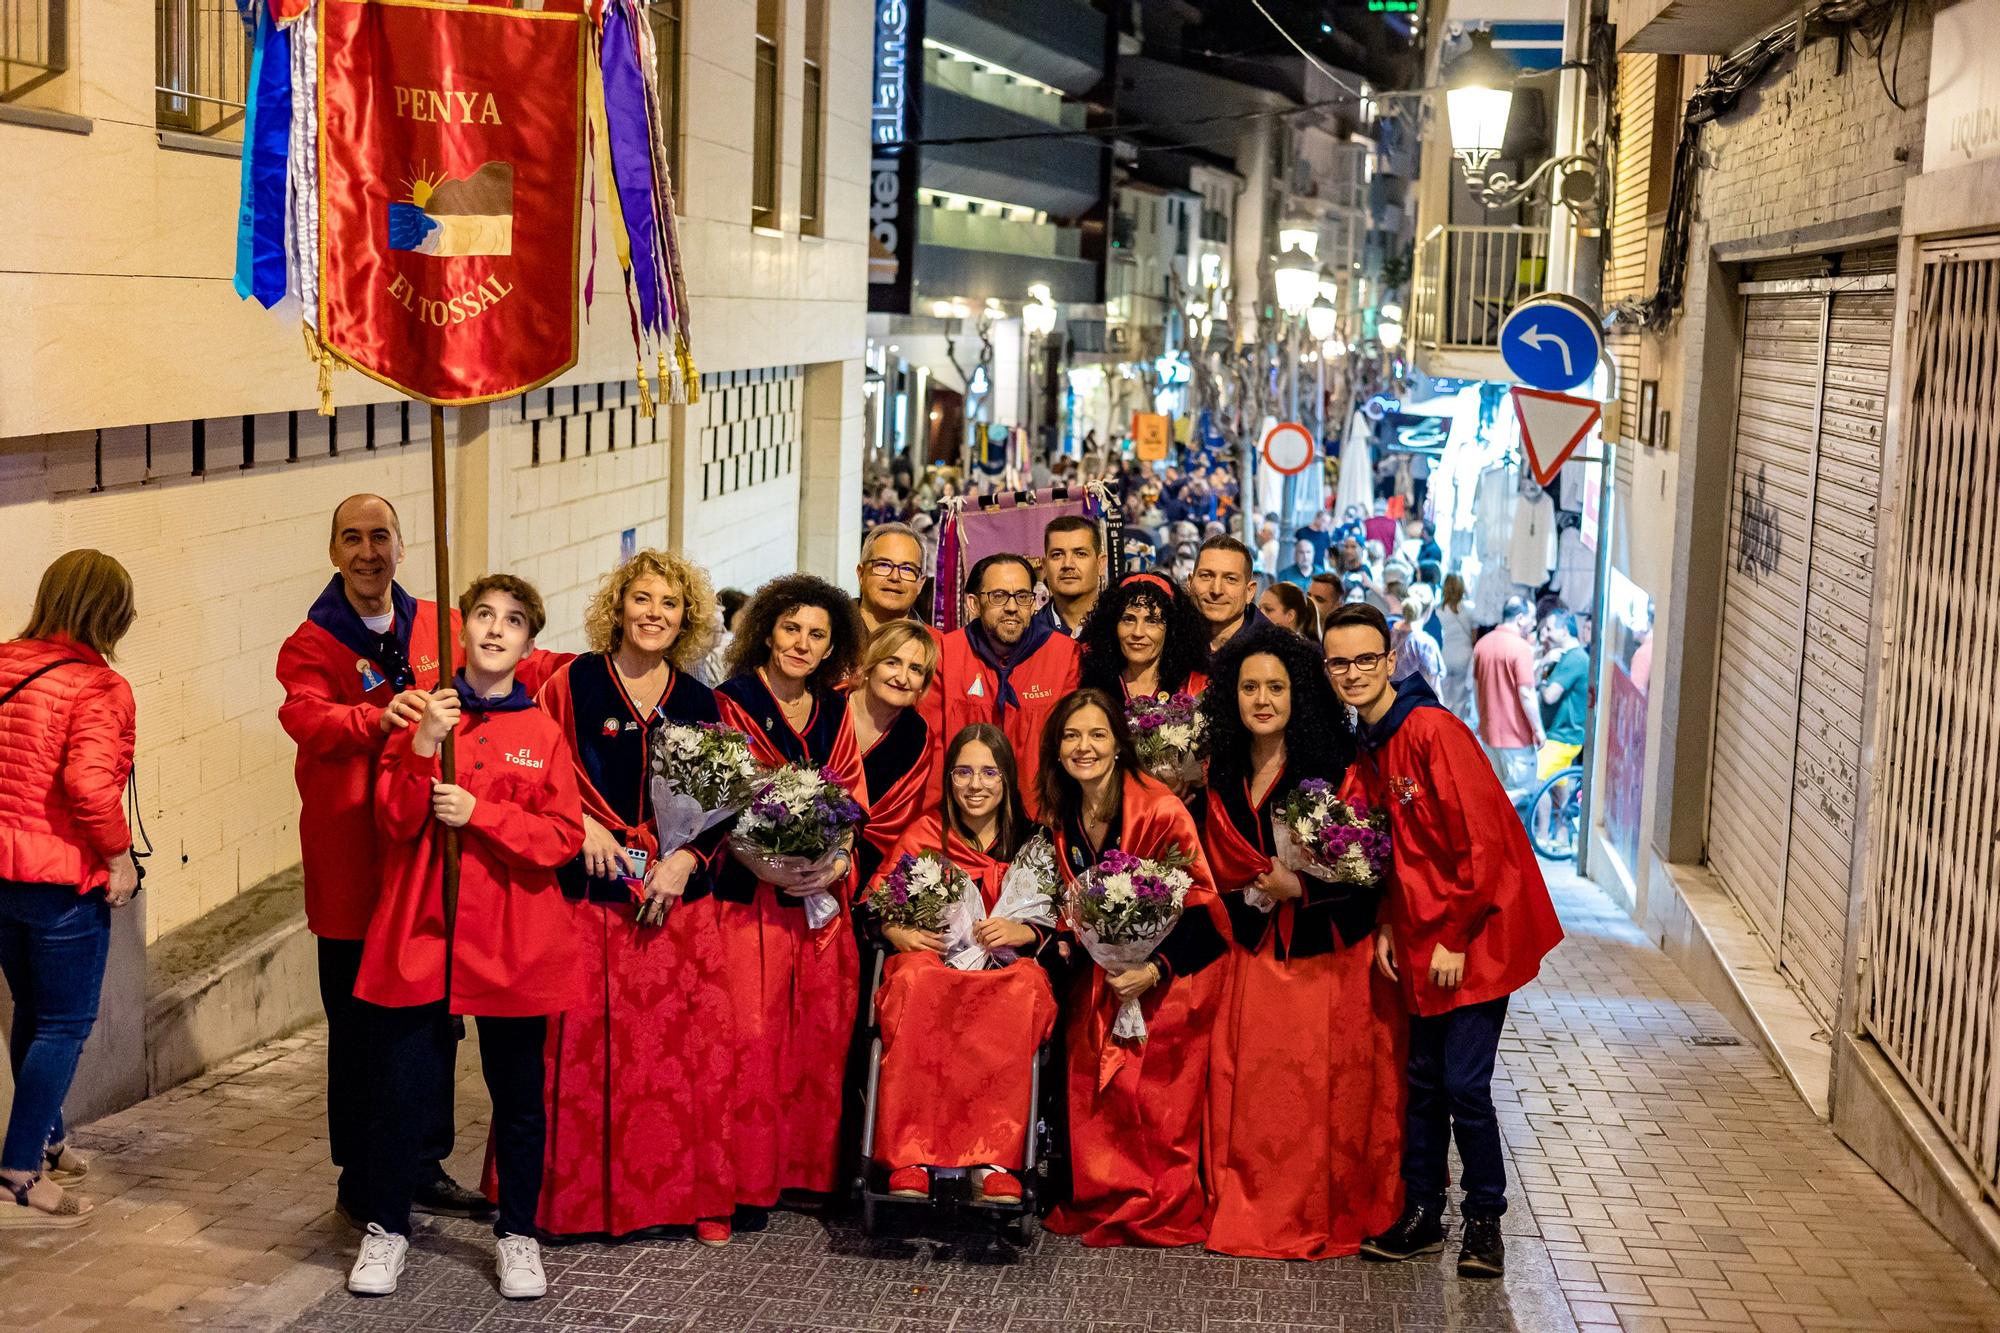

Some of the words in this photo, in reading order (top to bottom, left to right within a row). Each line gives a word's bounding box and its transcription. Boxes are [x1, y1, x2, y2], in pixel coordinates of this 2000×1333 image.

[394, 85, 502, 125] PENYA
[386, 271, 415, 312] EL
[418, 273, 513, 326] TOSSAL
[420, 655, 430, 664] El
[1022, 688, 1053, 700] Tossal
[1031, 684, 1040, 693] El
[518, 748, 531, 759] El
[504, 752, 544, 769] Tossal
